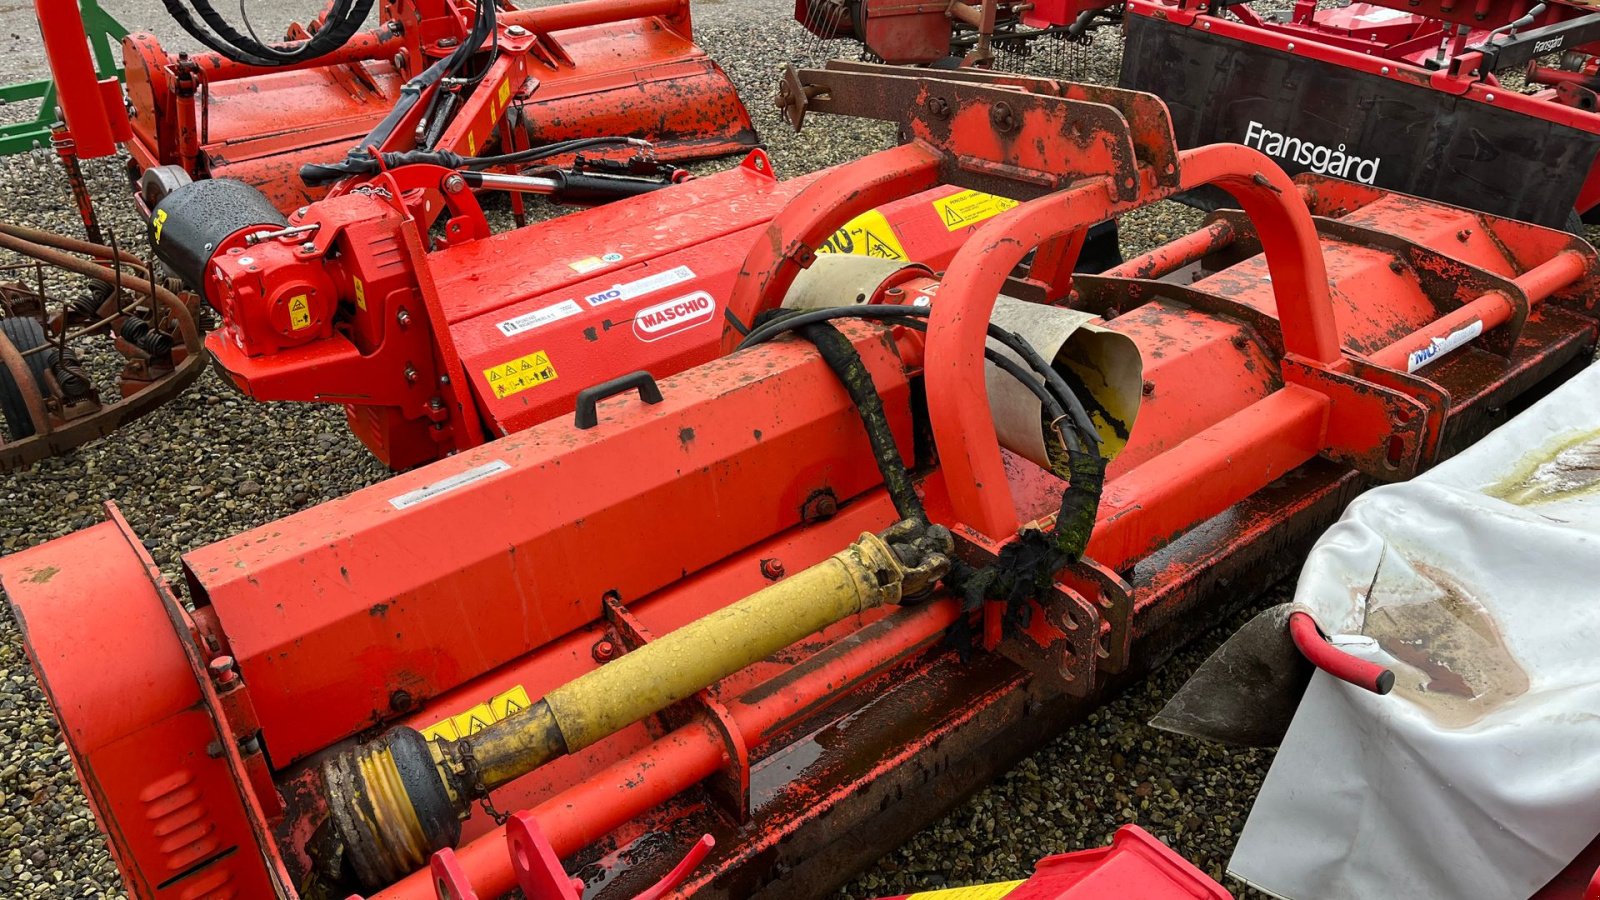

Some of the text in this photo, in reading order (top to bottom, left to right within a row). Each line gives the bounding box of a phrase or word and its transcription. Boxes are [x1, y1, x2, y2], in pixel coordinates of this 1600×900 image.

[1533, 35, 1565, 53] Fransgård
[1244, 120, 1380, 184] Fransgård
[641, 297, 709, 328] MASCHIO
